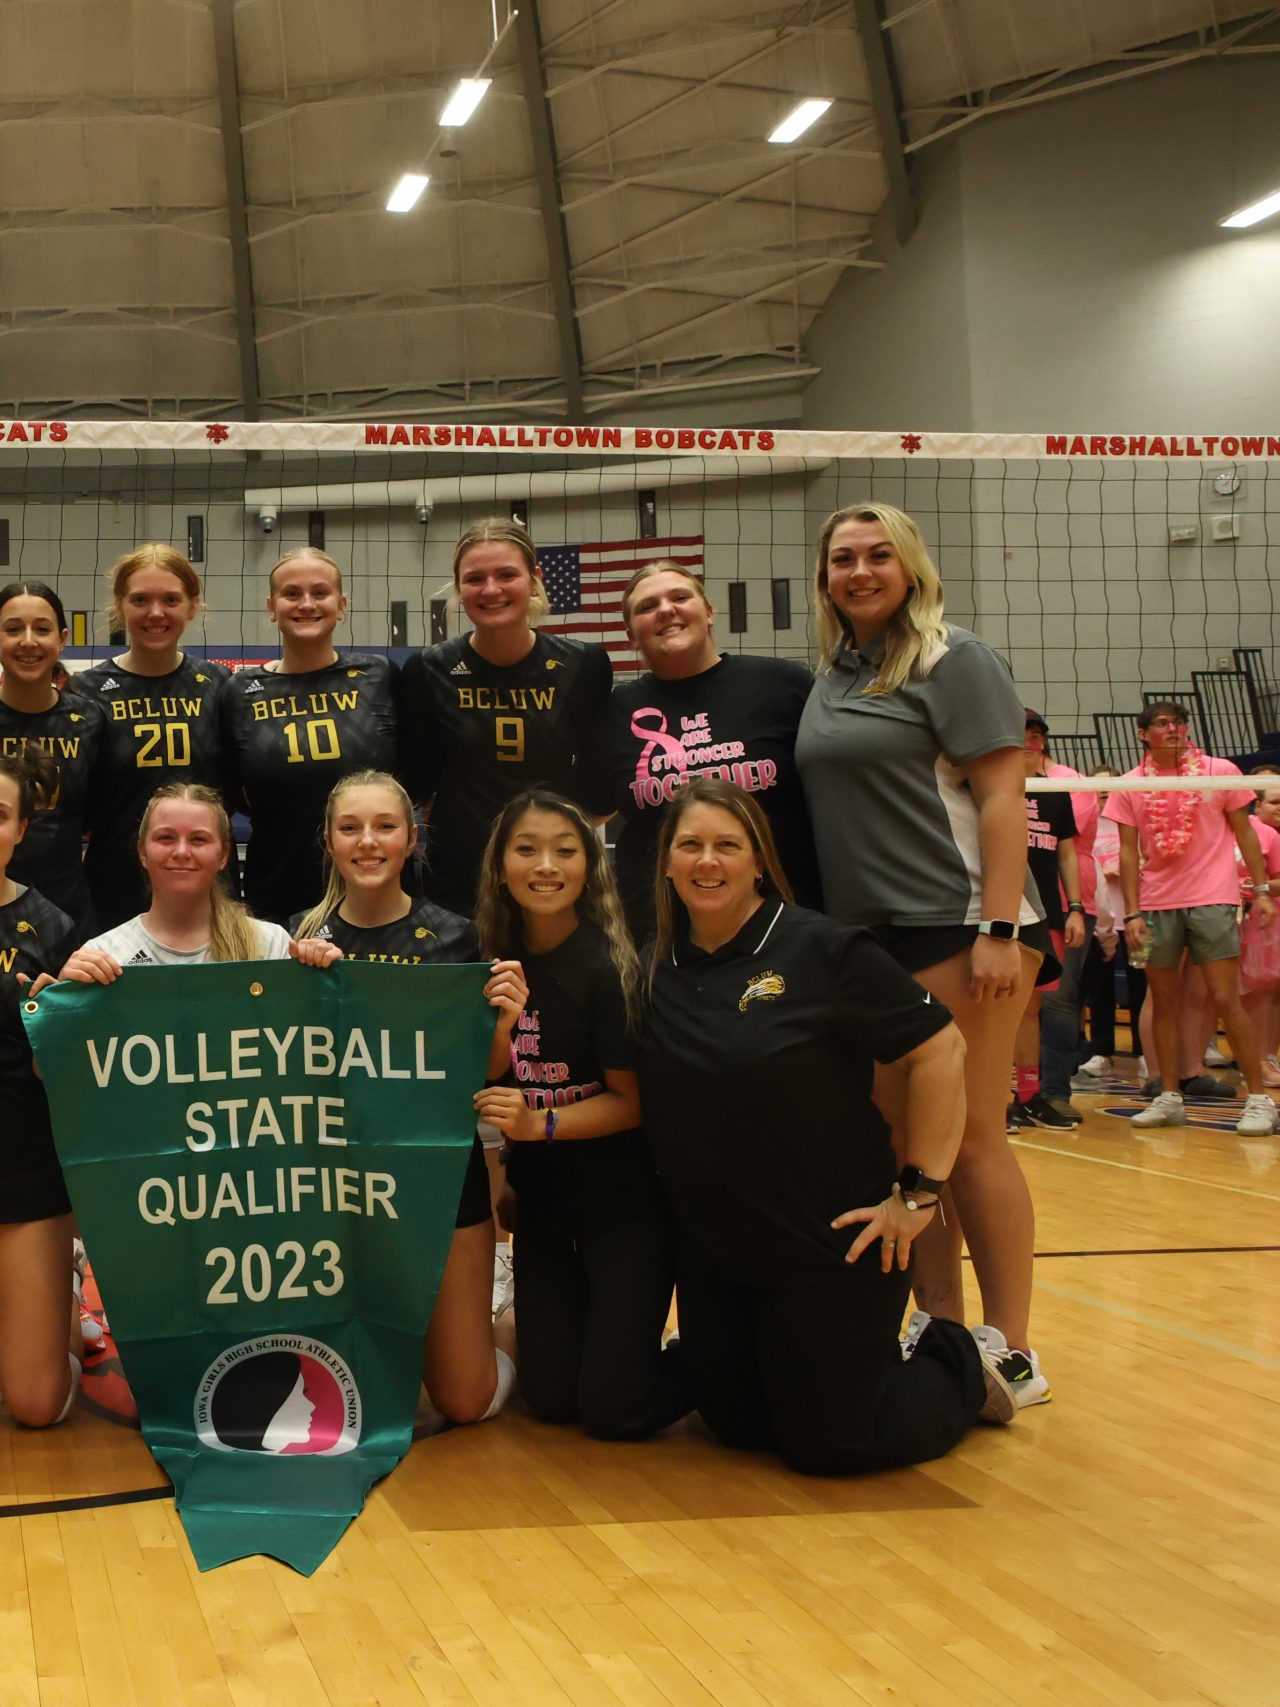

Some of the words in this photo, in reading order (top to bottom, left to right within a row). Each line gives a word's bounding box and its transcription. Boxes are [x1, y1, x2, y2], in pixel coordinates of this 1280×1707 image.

[365, 425, 621, 448] MARSHALLTOWN
[635, 429, 775, 450] BOBCATS
[1046, 436, 1280, 456] MARSHALLTOWN
[111, 698, 202, 720] BCLUW
[252, 690, 359, 721] BCLUW
[458, 686, 556, 711] BCLUW
[680, 713, 709, 731] WE
[134, 722, 191, 768] 20
[283, 718, 341, 764] 10
[495, 716, 525, 762] 9
[679, 728, 713, 747] ARE
[651, 741, 746, 772] STRONGER
[128, 956, 153, 965] adidas
[518, 1010, 540, 1031] WE
[86, 1026, 446, 1088] VOLLEYBALL
[513, 1034, 540, 1056] ARE
[186, 1095, 347, 1153] STATE
[138, 1167, 399, 1226] QUALIFIER
[205, 1240, 345, 1305] 2023
[224, 1345, 254, 1364] HIGH
[255, 1338, 304, 1351] SCHOOL
[203, 1361, 226, 1393] GIRLS
[305, 1343, 351, 1388] ATHLETIC
[199, 1397, 208, 1423] IOWA
[345, 1389, 357, 1429] UNION
